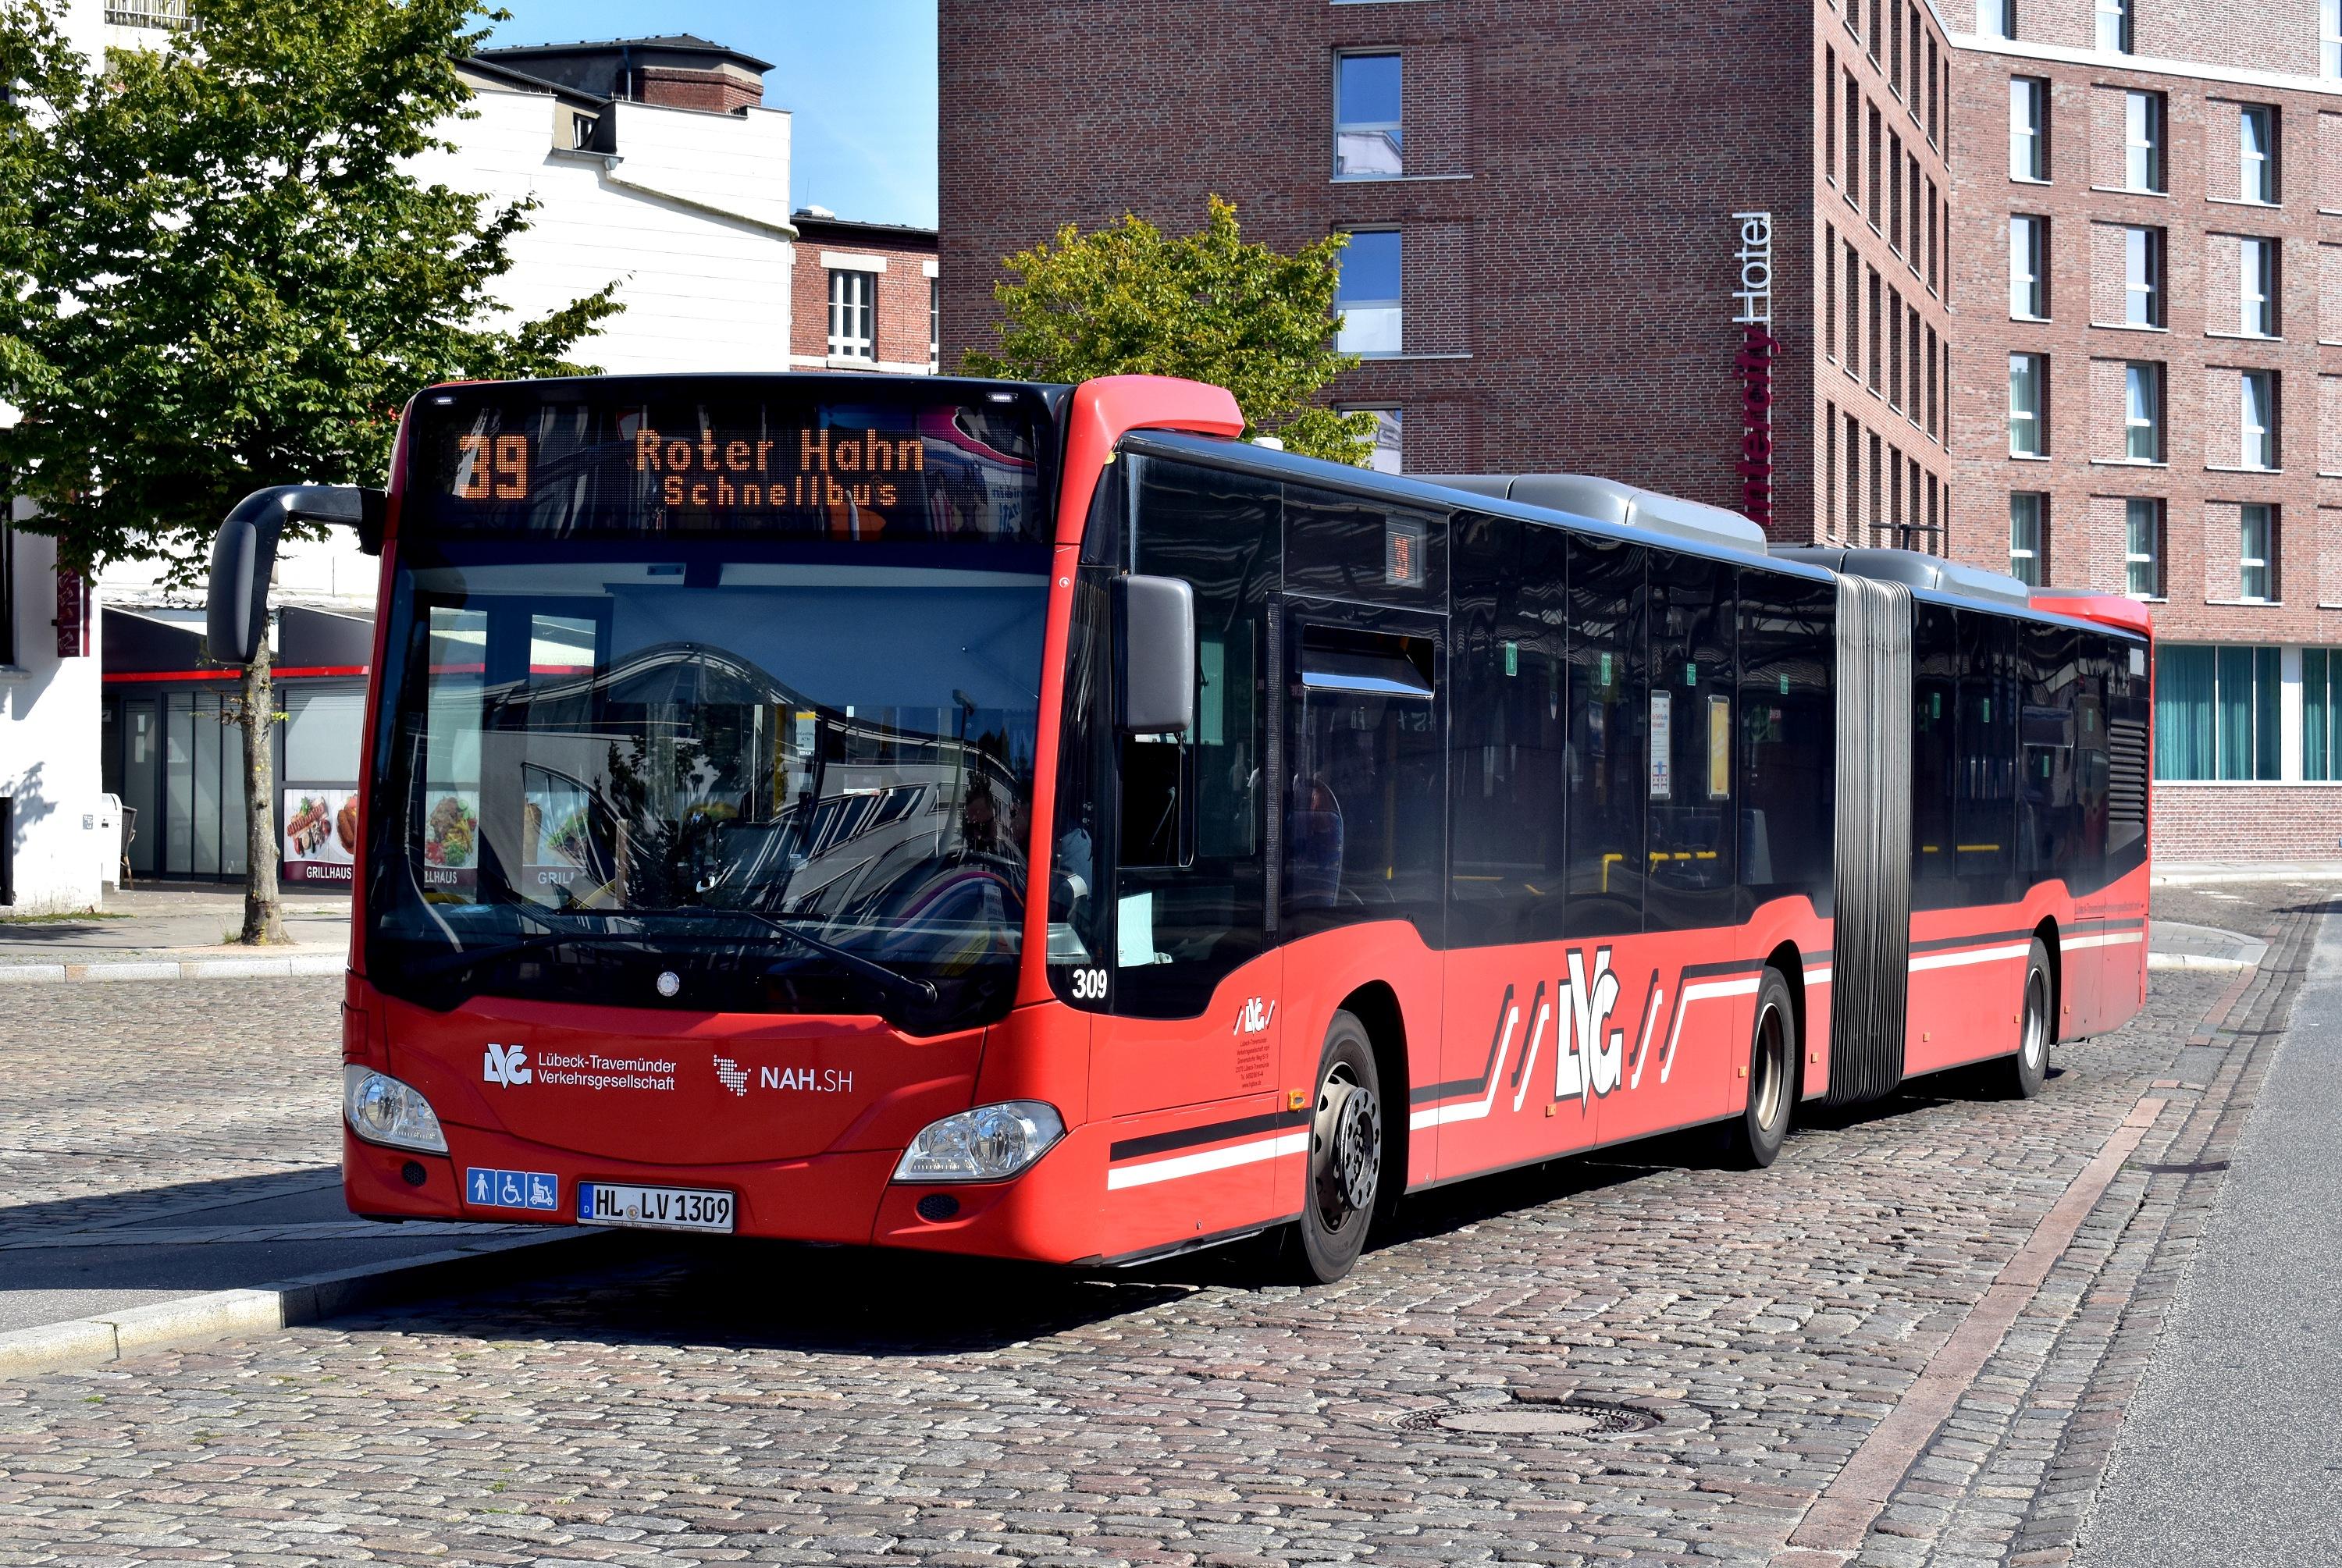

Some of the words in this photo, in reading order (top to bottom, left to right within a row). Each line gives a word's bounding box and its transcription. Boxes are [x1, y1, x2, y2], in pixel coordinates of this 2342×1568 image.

[636, 429, 774, 470] Roter
[801, 429, 923, 470] Hahn
[459, 436, 527, 499] 39
[664, 475, 896, 506] Schnellbus
[306, 866, 352, 880] GRILLHAUS
[1073, 969, 1108, 999] 309
[1244, 996, 1265, 1036] LVG
[1554, 944, 1625, 1122] LVG
[484, 1044, 532, 1090] LVG
[538, 1052, 677, 1073] Lübeck-Travemünder
[538, 1069, 675, 1091] Verkehrsgesellschaft
[760, 1066, 852, 1092] NAH.SH
[583, 1205, 590, 1214] D
[596, 1189, 624, 1217] HL
[641, 1193, 670, 1220] LV
[674, 1195, 730, 1224] 1309
